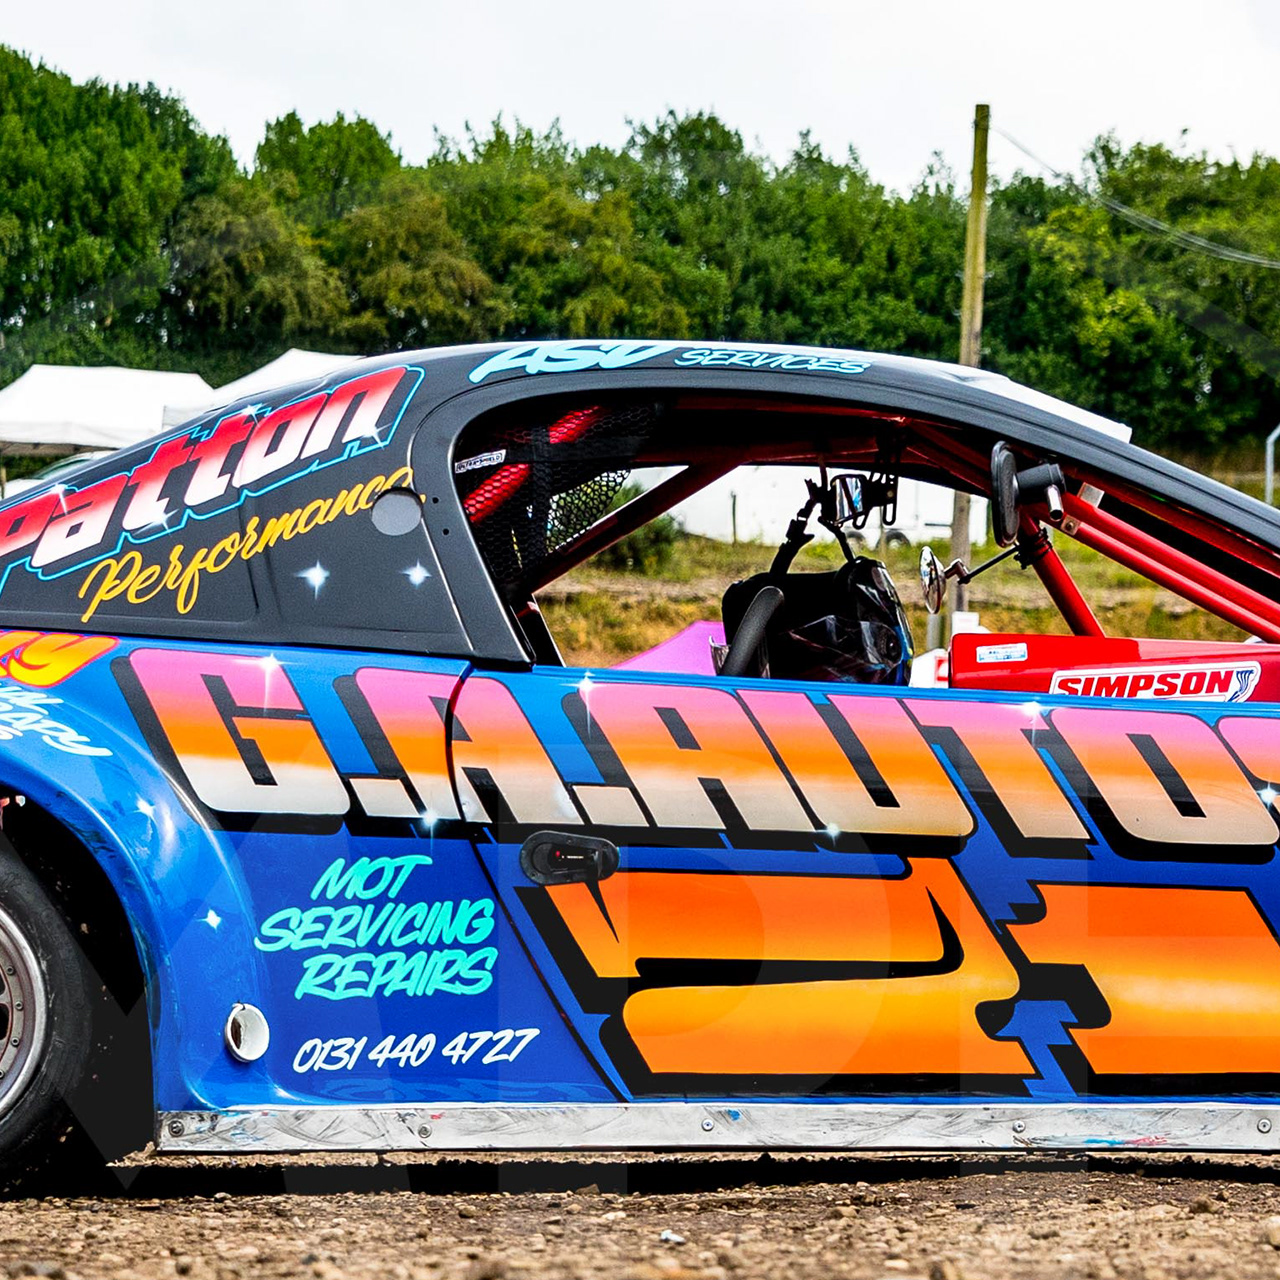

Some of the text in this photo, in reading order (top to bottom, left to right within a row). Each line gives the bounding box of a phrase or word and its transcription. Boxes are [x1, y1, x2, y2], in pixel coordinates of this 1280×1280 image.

[673, 348, 871, 375] SERVICES
[1056, 669, 1235, 699] SIMPSON
[310, 854, 433, 901] MOT
[254, 897, 496, 951] SERVICING
[293, 946, 500, 1001] REPAIRS
[292, 1027, 541, 1074] 0131 440 4727
